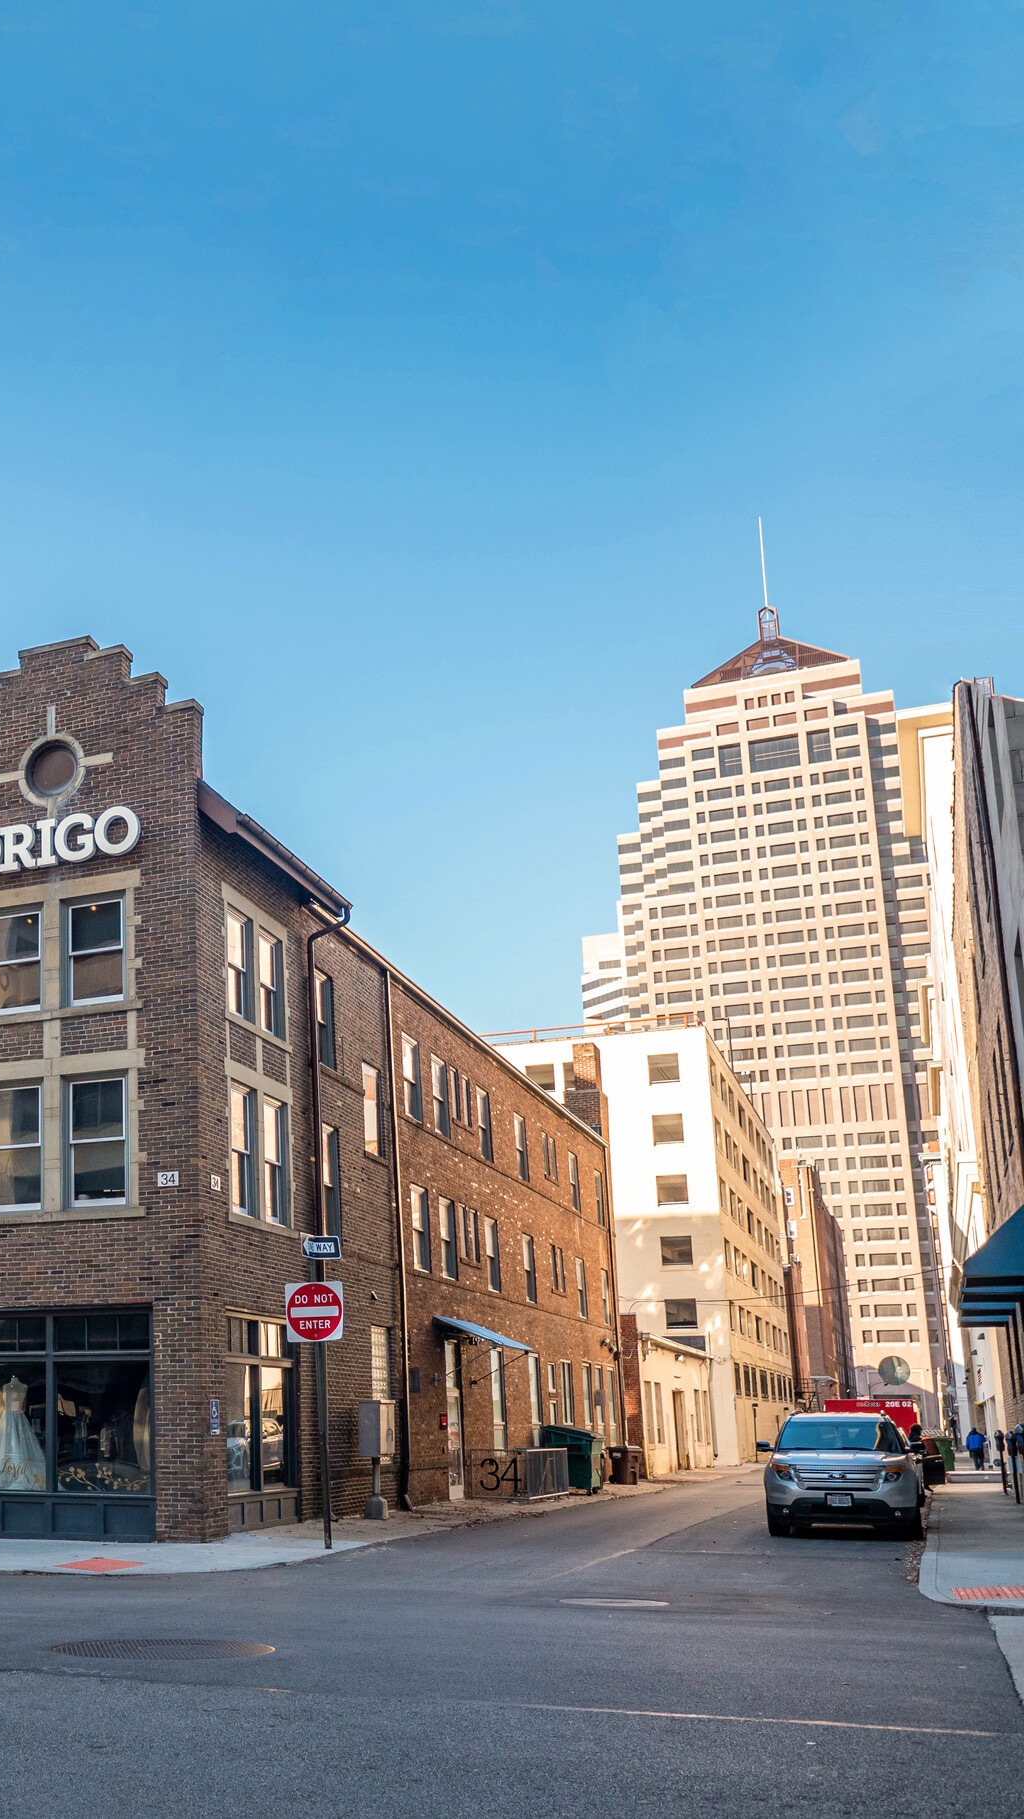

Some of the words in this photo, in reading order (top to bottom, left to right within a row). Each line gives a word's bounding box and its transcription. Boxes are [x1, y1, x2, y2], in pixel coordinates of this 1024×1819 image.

[161, 1173, 176, 1185] 34
[316, 1243, 333, 1252] WAY
[294, 1295, 308, 1304] DO
[314, 1293, 334, 1303] NOT
[299, 1320, 331, 1330] ENTER
[480, 1458, 522, 1492] 34
